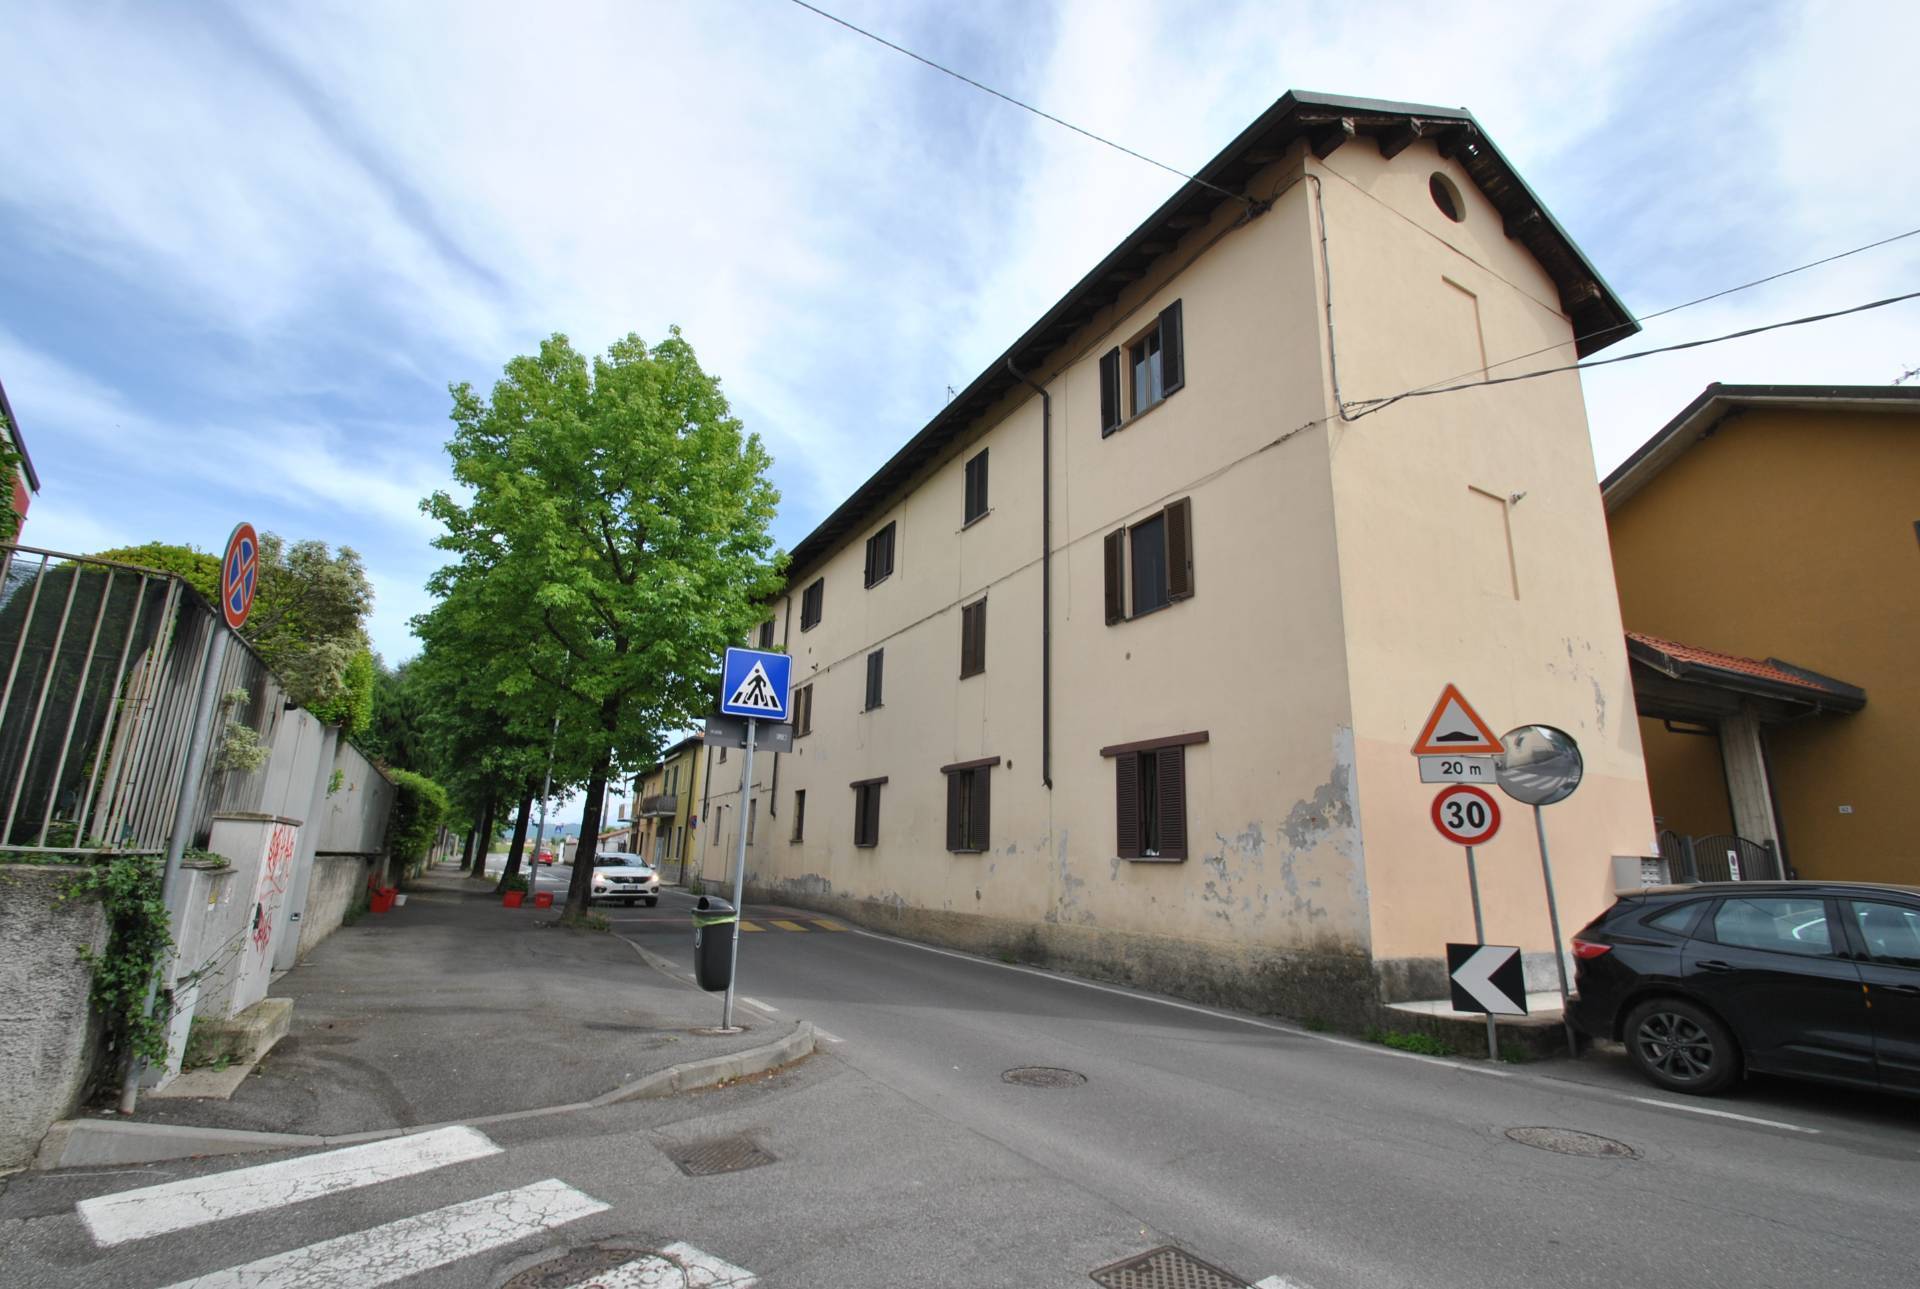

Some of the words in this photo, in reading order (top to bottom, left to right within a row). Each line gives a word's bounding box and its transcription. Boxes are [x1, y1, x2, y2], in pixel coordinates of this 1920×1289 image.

[1441, 761, 1463, 775] 20
[1470, 765, 1482, 775] m
[1446, 801, 1485, 829] 30
